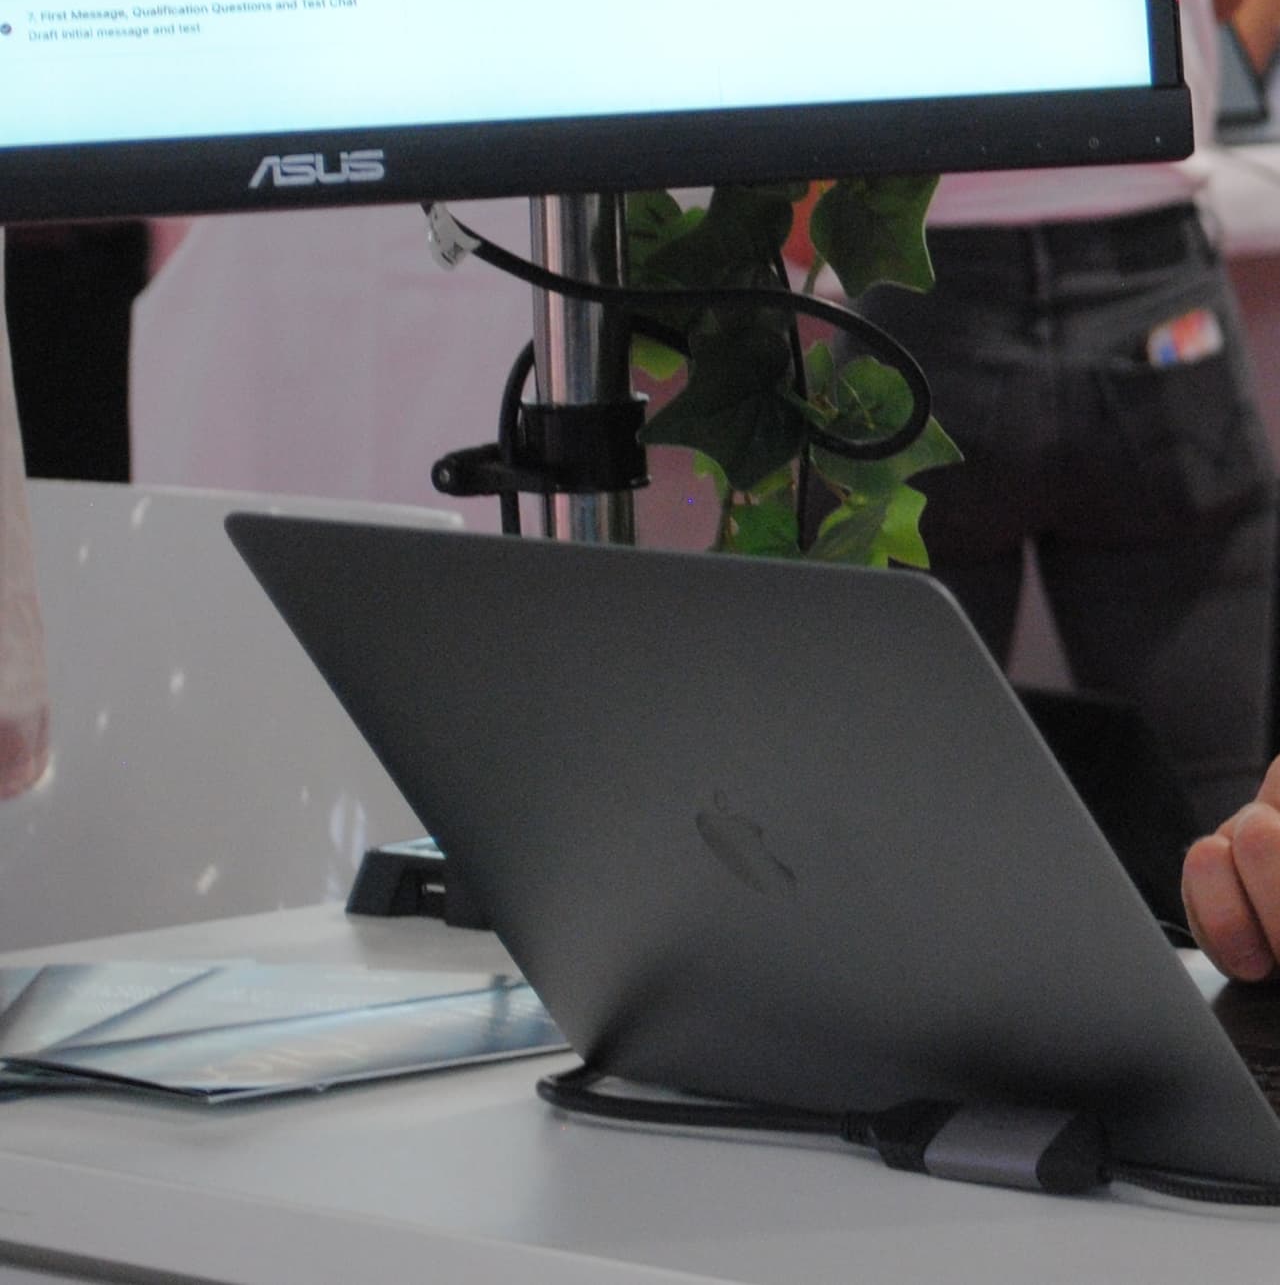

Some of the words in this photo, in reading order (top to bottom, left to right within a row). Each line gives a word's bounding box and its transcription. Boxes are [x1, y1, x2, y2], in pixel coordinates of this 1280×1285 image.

[40, 8, 67, 21] First
[132, 1, 208, 18] Qualification
[211, 0, 272, 17] Questions
[274, 0, 298, 11] and
[28, 28, 59, 42] Draft
[96, 25, 150, 41] message
[152, 23, 175, 36] and
[177, 21, 201, 35] test
[248, 148, 386, 190] ASUS
